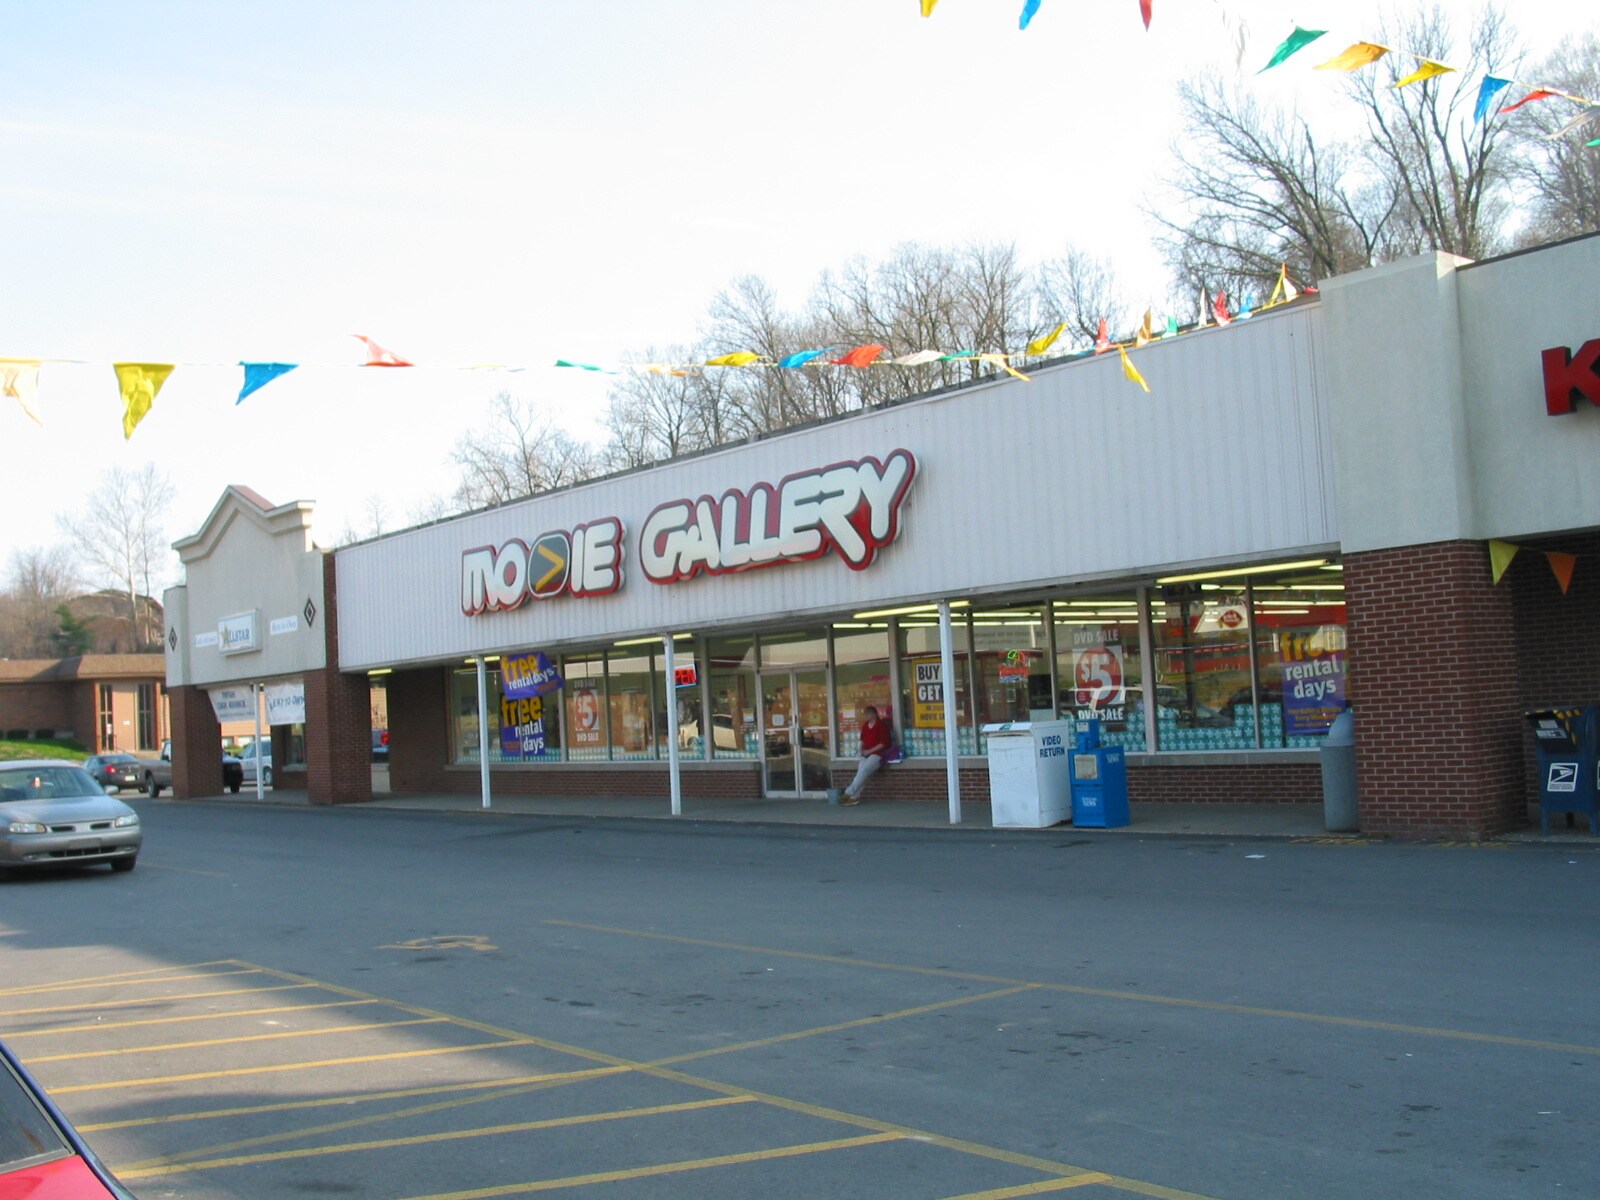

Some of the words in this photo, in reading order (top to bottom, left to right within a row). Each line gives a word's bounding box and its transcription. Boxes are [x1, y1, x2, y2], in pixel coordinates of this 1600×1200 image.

[639, 448, 918, 584] GALLERY
[1073, 631, 1093, 645] DVD
[1095, 628, 1119, 643] SALE
[501, 655, 540, 684] free
[673, 667, 697, 685] PEN
[917, 665, 940, 680] BUY
[1080, 653, 1113, 700] $5
[1285, 655, 1340, 681] rental
[508, 673, 535, 690] rental
[918, 685, 941, 701] GET
[1293, 680, 1337, 701] days
[501, 694, 543, 728] free
[1077, 709, 1098, 720] DVD
[1100, 707, 1124, 721] SALE
[523, 737, 544, 754] days
[1041, 735, 1062, 746] VIDEO
[1039, 746, 1066, 758] RETURN
